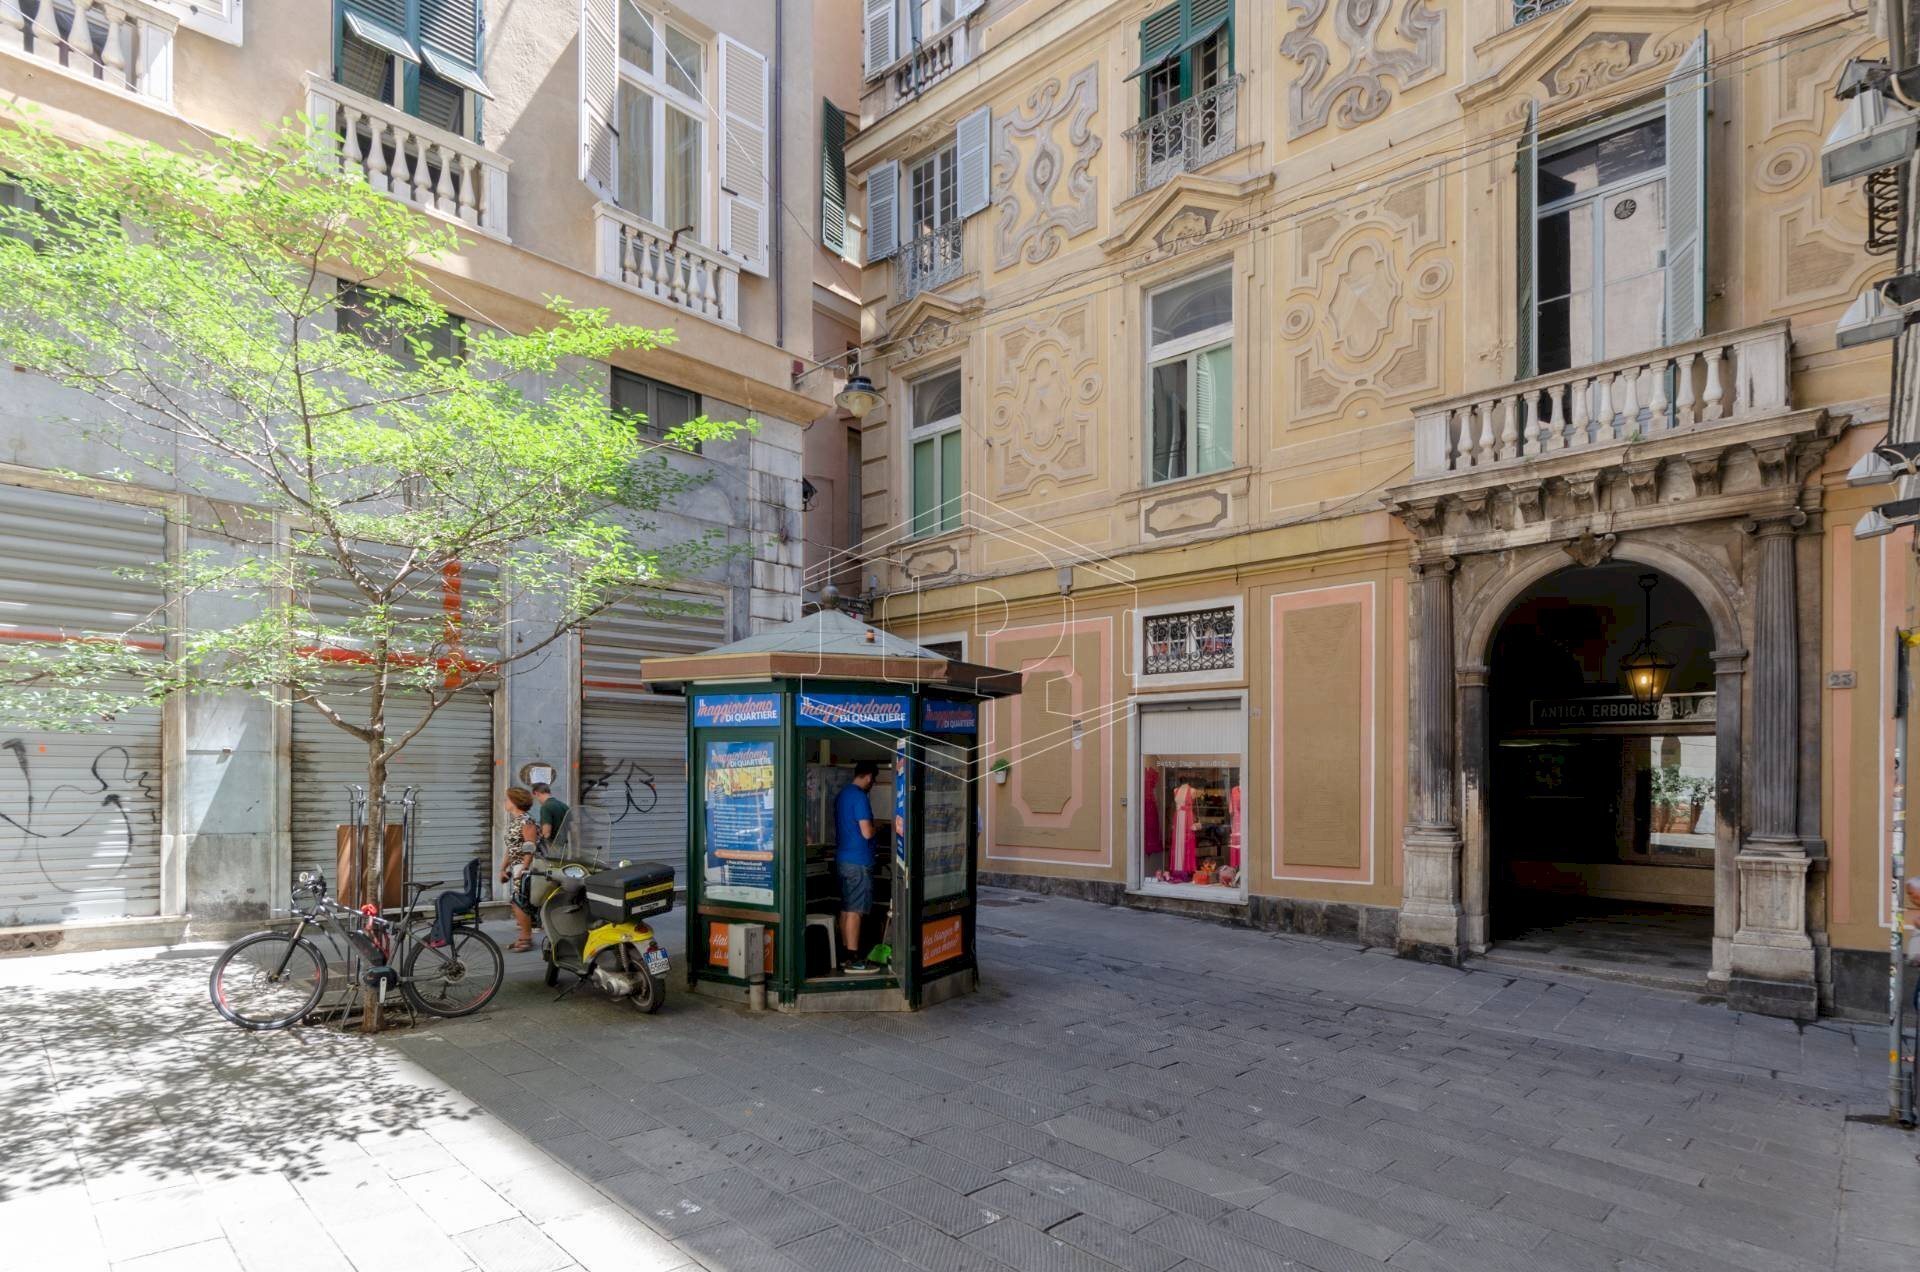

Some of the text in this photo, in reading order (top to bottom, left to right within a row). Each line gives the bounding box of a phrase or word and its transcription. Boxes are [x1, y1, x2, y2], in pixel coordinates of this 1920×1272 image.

[1830, 674, 1852, 686] 23
[697, 697, 773, 723] maggiordomo
[725, 709, 778, 722] DI QUARTIERE
[802, 697, 901, 723] maggiordomo
[1541, 705, 1586, 718] ANTICA
[839, 711, 907, 723] DI QUARTIERE
[950, 719, 976, 728] QUARTIERE
[738, 757, 772, 767] QUARTIERE
